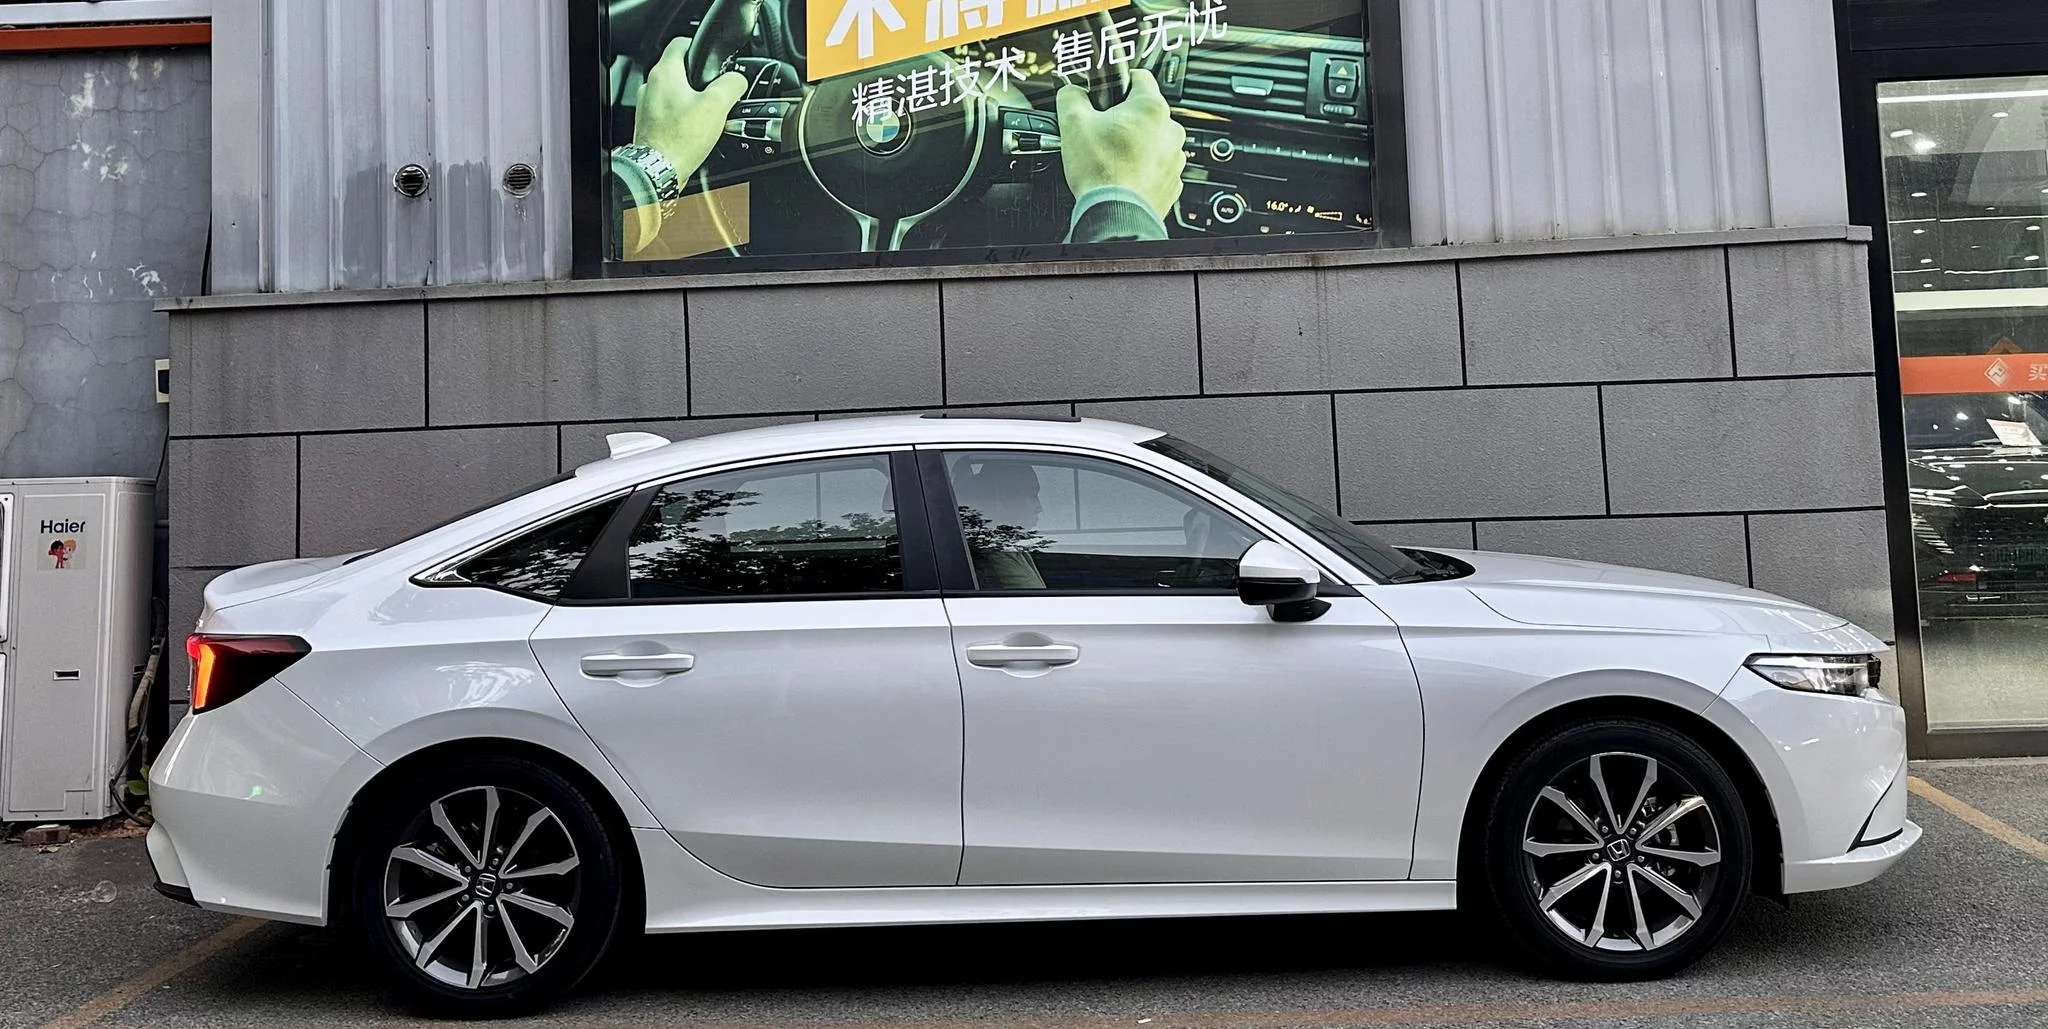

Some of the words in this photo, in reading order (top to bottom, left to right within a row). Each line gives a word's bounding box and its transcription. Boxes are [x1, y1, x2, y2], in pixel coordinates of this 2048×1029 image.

[851, 46, 1027, 127] 精湛技术
[1052, 0, 1228, 77] 售后无忧
[40, 518, 86, 534] Haier
